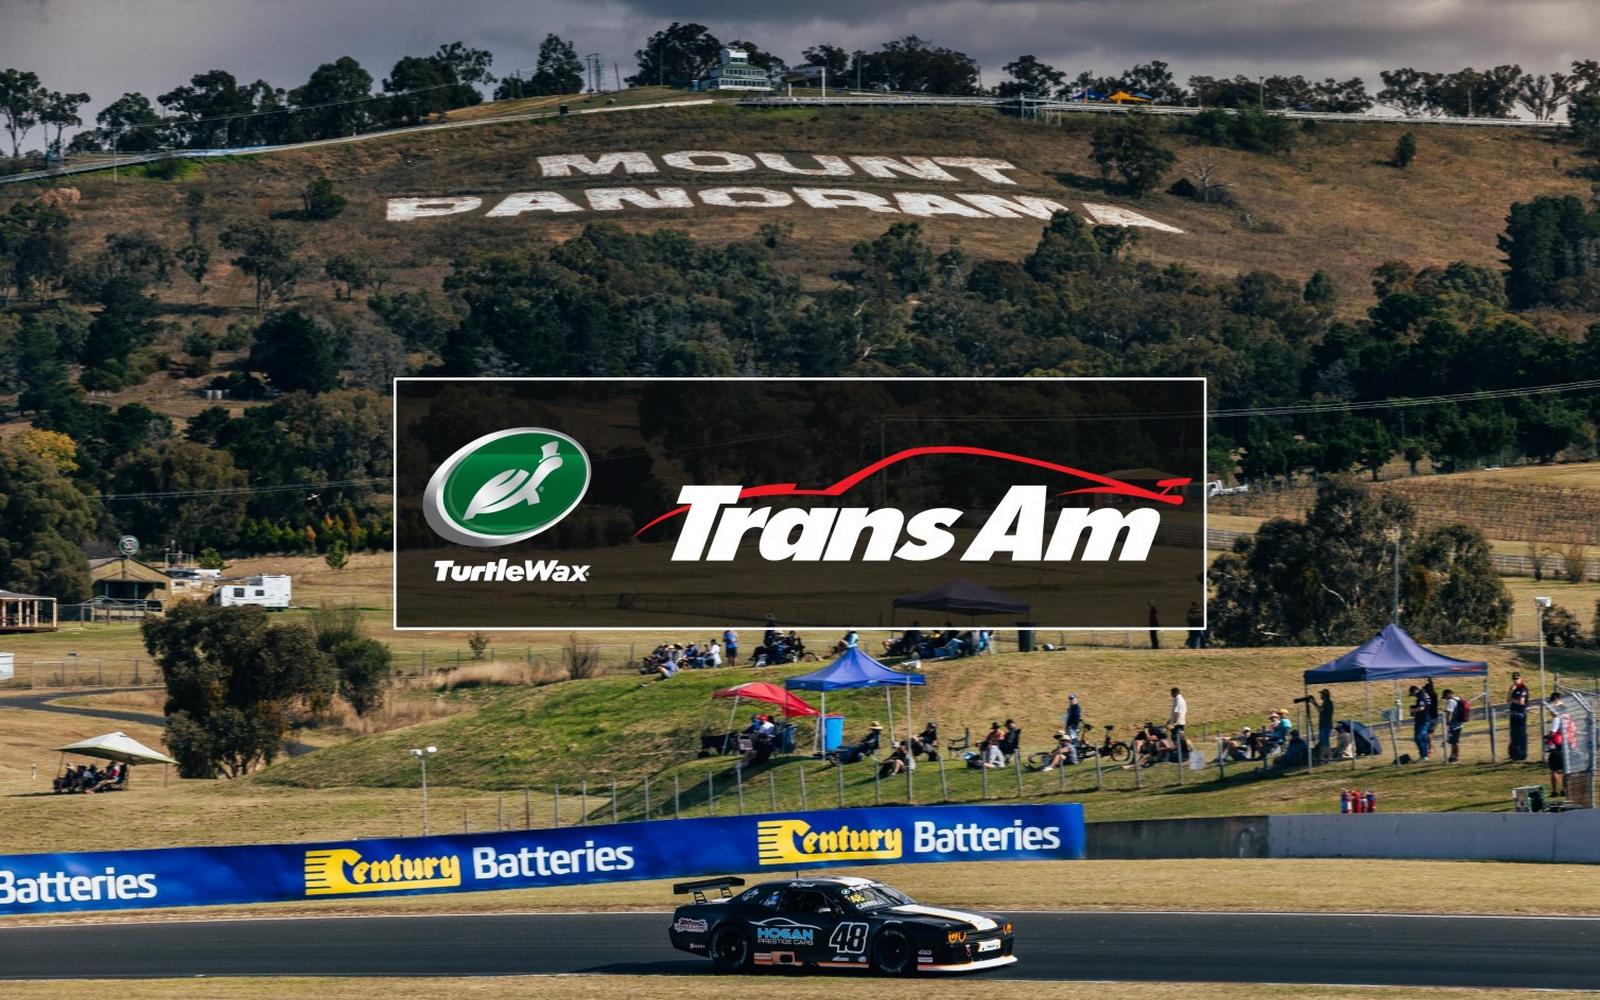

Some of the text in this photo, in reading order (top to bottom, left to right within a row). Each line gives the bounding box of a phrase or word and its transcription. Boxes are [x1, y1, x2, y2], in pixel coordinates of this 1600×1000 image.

[537, 150, 1018, 185] MOUNT
[386, 187, 1185, 234] PANORAMA
[757, 819, 1061, 865] Century Batteries
[0, 866, 158, 905] Batteries
[304, 840, 635, 896] Century Batteries
[757, 927, 814, 941] HOGAN
[828, 921, 869, 954] 48
